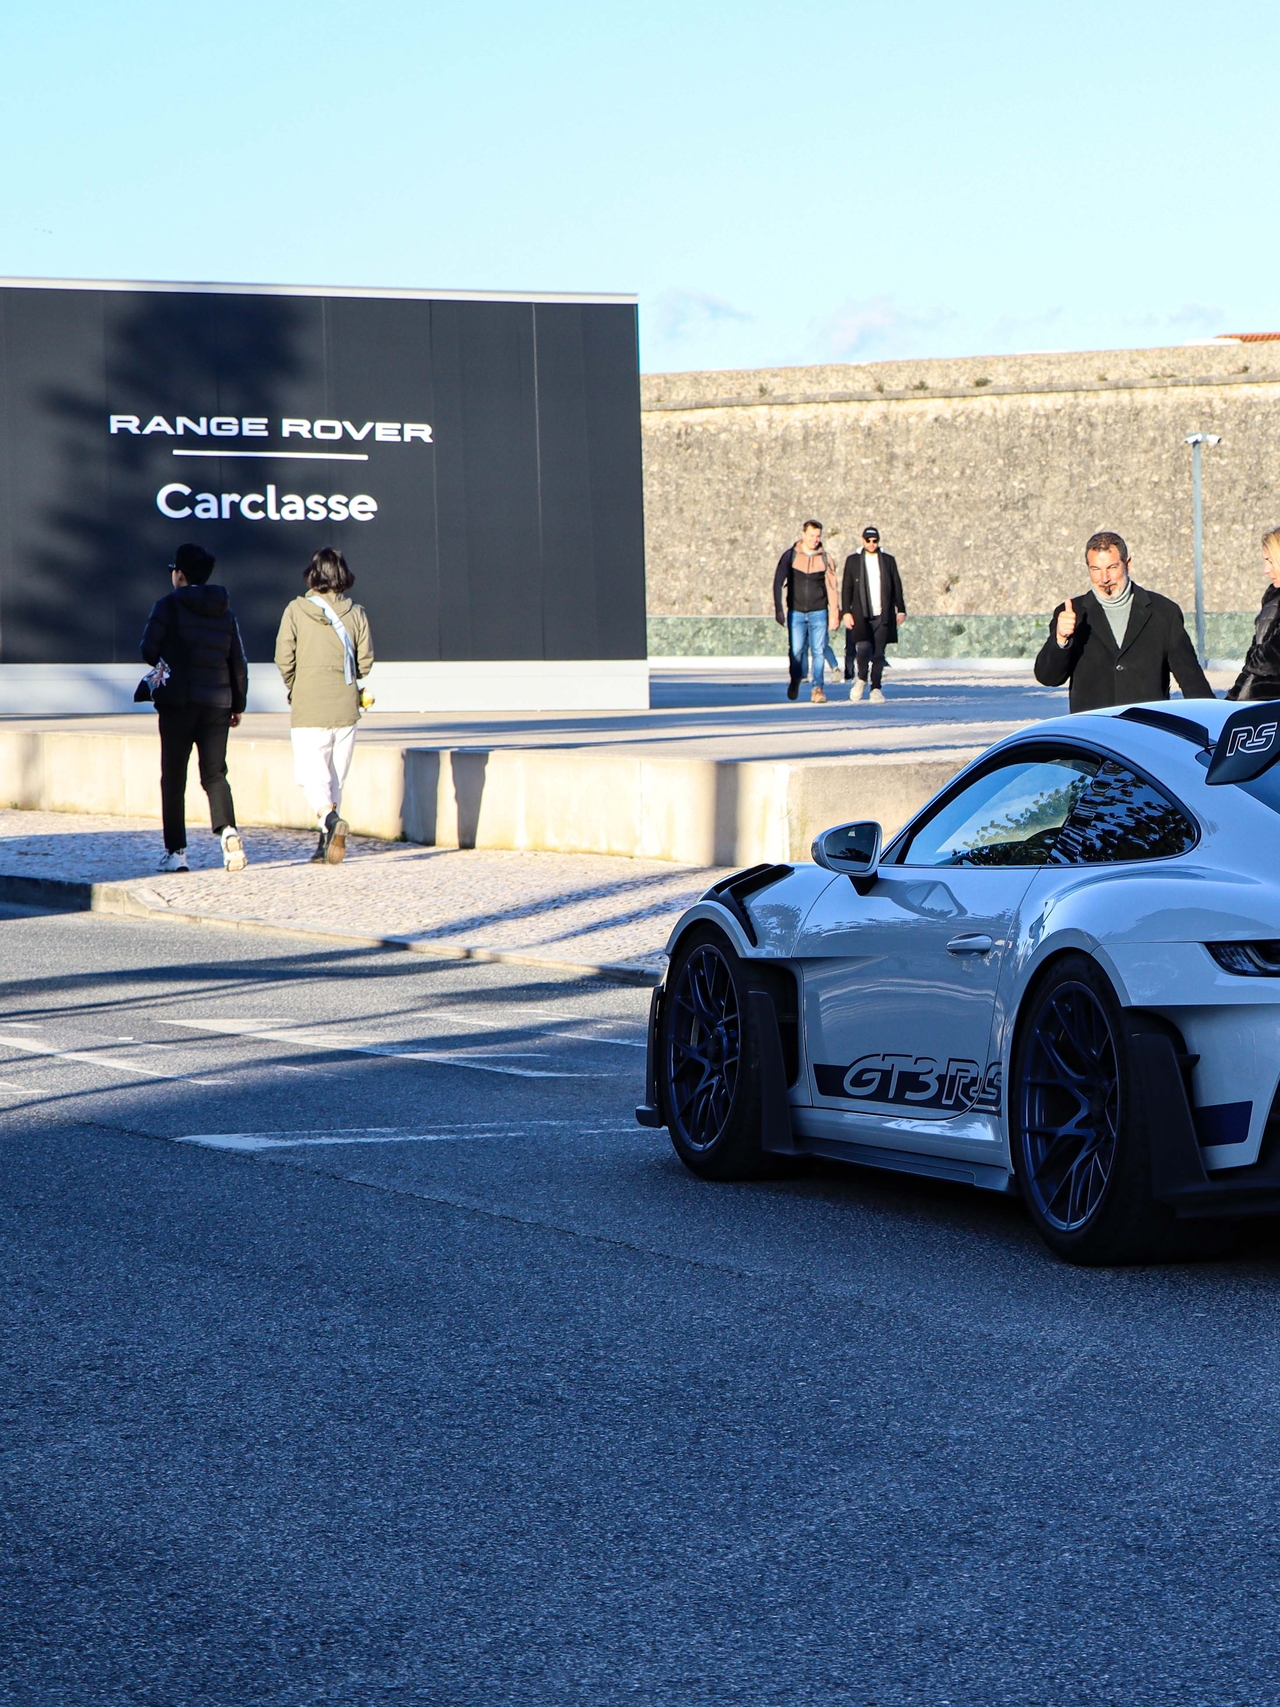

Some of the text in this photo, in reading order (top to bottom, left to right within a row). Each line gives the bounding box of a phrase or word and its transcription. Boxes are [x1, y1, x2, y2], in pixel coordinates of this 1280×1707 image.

[109, 414, 434, 443] RANGE ROVER
[156, 483, 379, 522] Carclasse
[1226, 722, 1278, 757] RS
